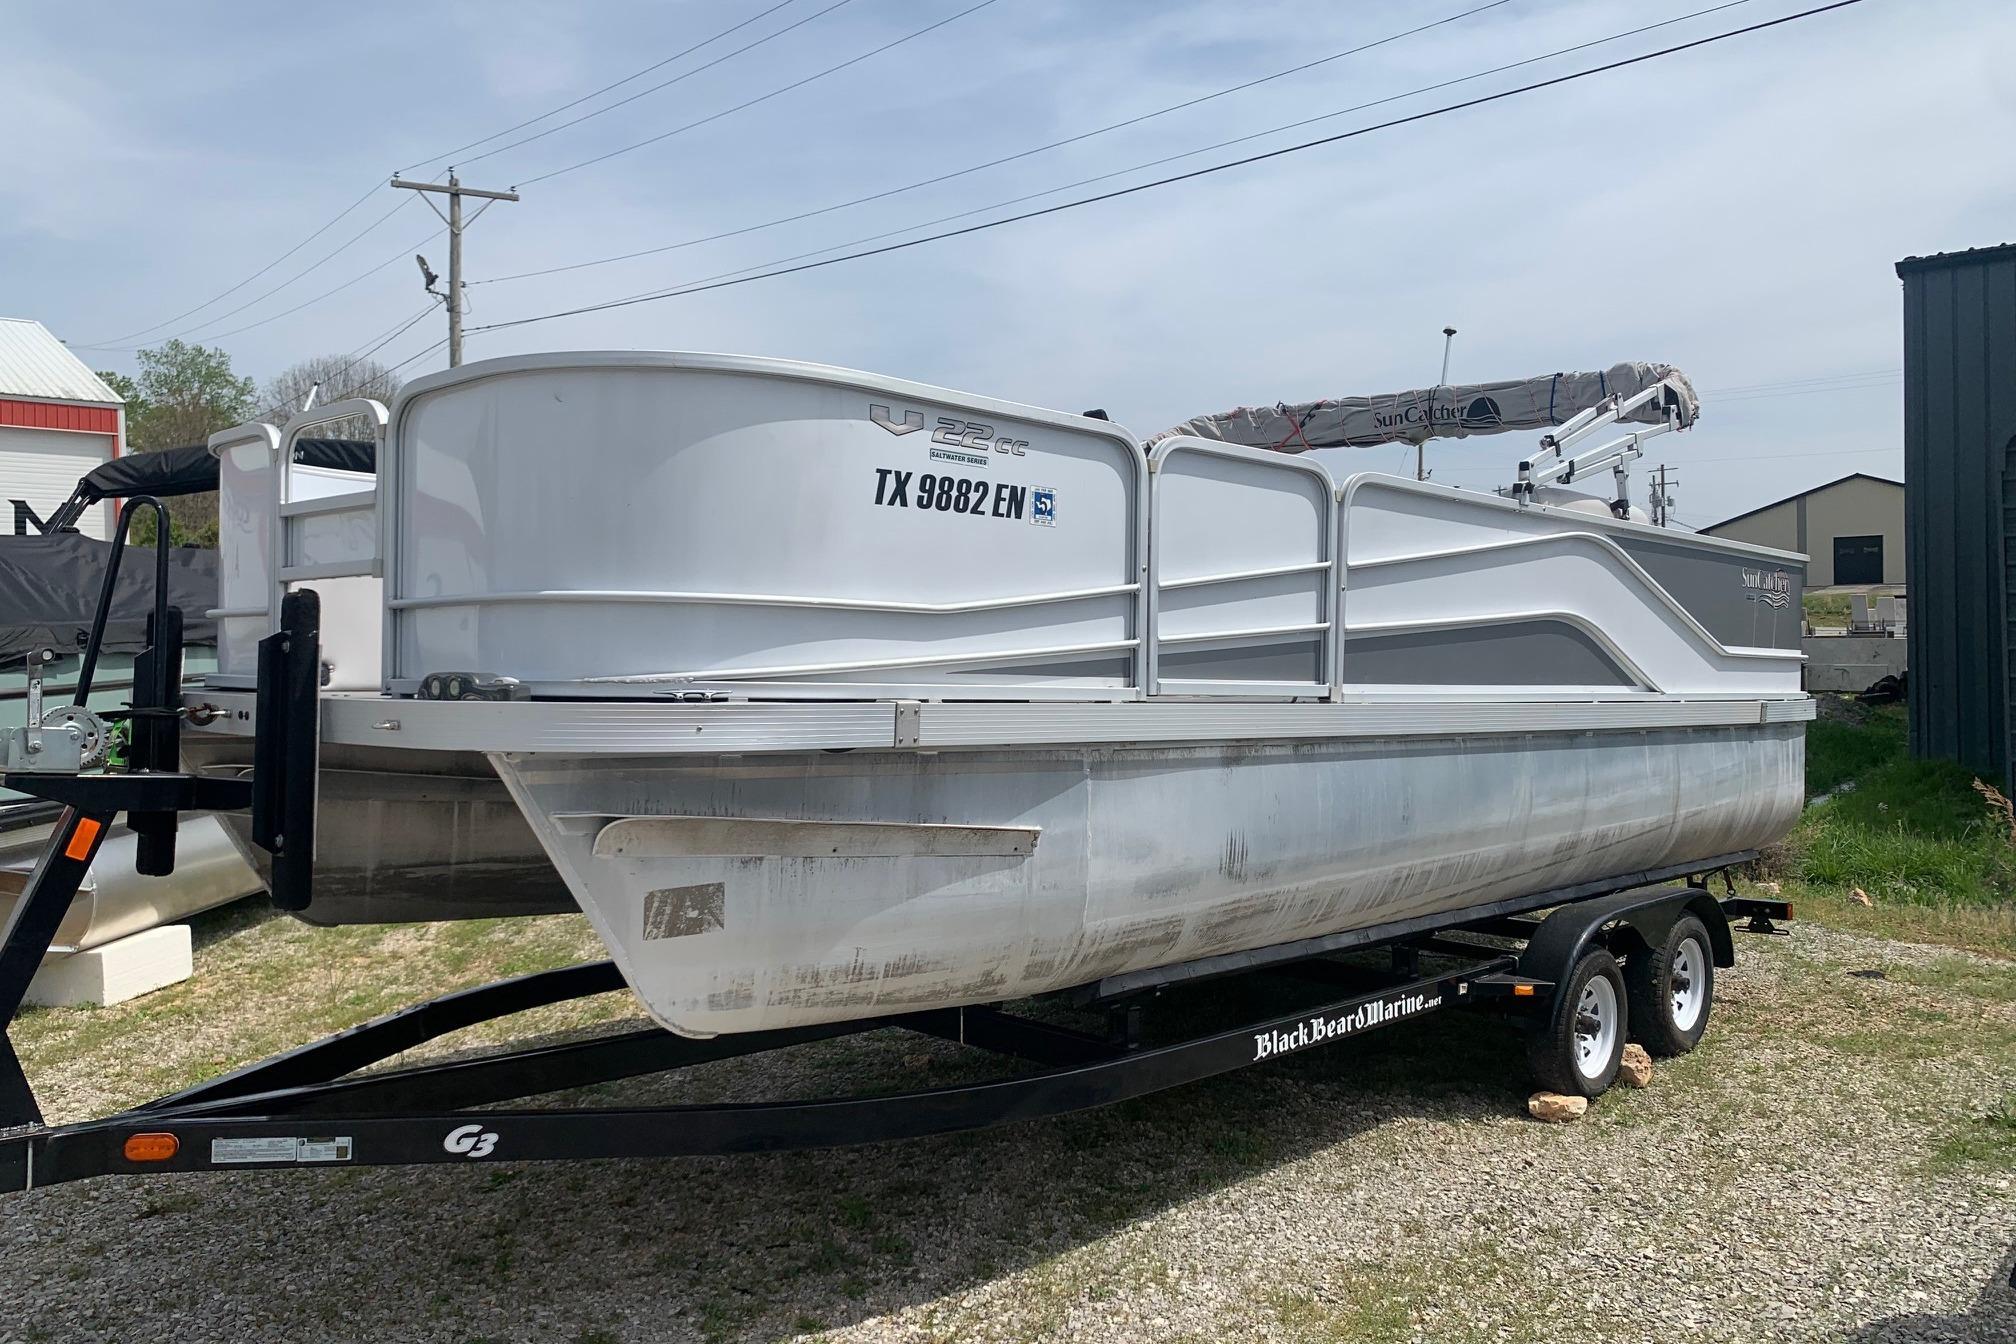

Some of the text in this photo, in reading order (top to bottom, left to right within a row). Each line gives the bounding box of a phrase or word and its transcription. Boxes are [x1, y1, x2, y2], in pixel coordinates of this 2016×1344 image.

[1374, 404, 1467, 429] SunCatcher
[931, 451, 987, 466] SALTWATER SERIES
[874, 468, 913, 507] TX
[916, 474, 989, 516] 9882
[991, 483, 1027, 520] EN
[444, 1124, 499, 1158] G3
